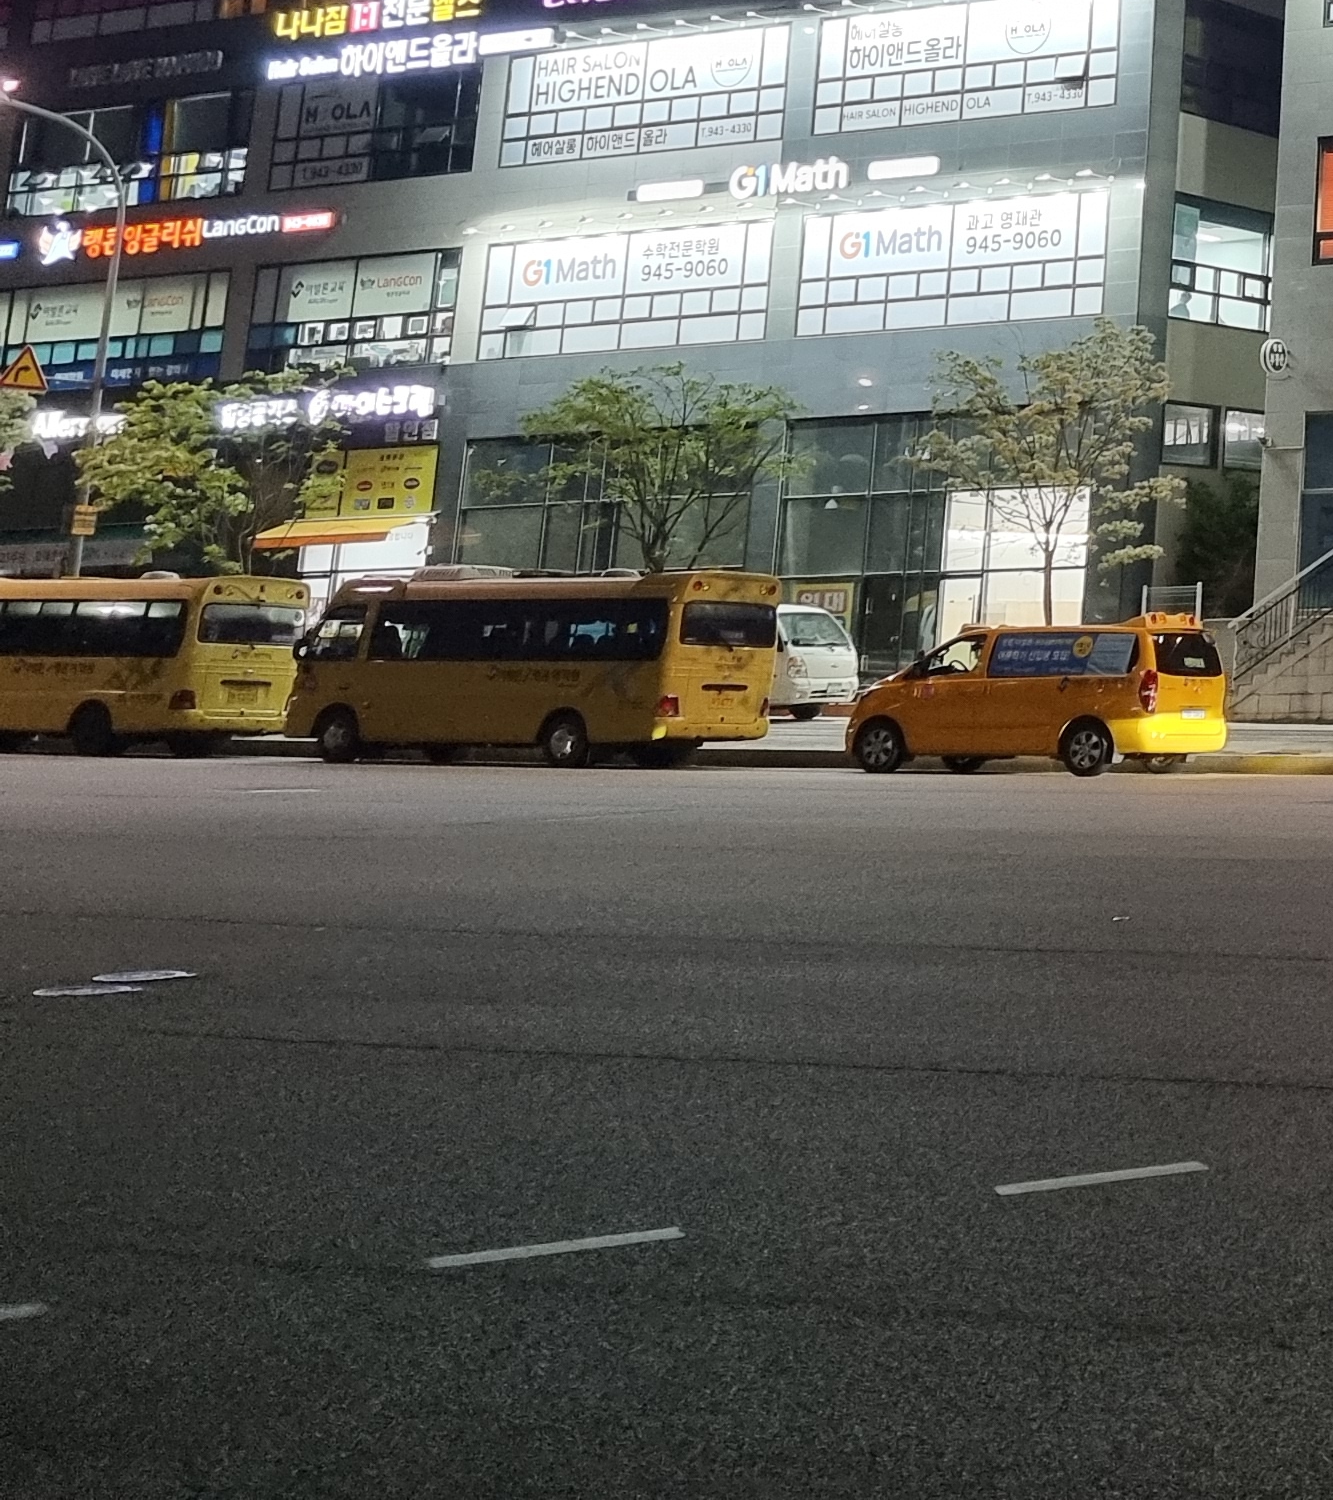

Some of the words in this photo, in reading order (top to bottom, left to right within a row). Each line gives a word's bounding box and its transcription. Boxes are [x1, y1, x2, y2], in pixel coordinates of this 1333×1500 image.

[275, 4, 349, 41] 나나짐
[850, 35, 963, 71] 하이앤드올라
[537, 57, 577, 79] HAIR
[535, 72, 640, 106] HIGHEND
[650, 66, 697, 93] OLA
[843, 111, 863, 122] HAIR
[865, 107, 896, 120] SALON
[903, 100, 958, 117] HIGHEND
[966, 97, 991, 110] OLA
[531, 137, 577, 157] 헤어살롱
[643, 128, 668, 147] 올라
[966, 212, 995, 231] 과고
[1001, 209, 1042, 230] 영재관
[642, 237, 720, 261] 수학전문학원
[965, 229, 1062, 255] 945-9060
[641, 258, 728, 282] 945-9060
